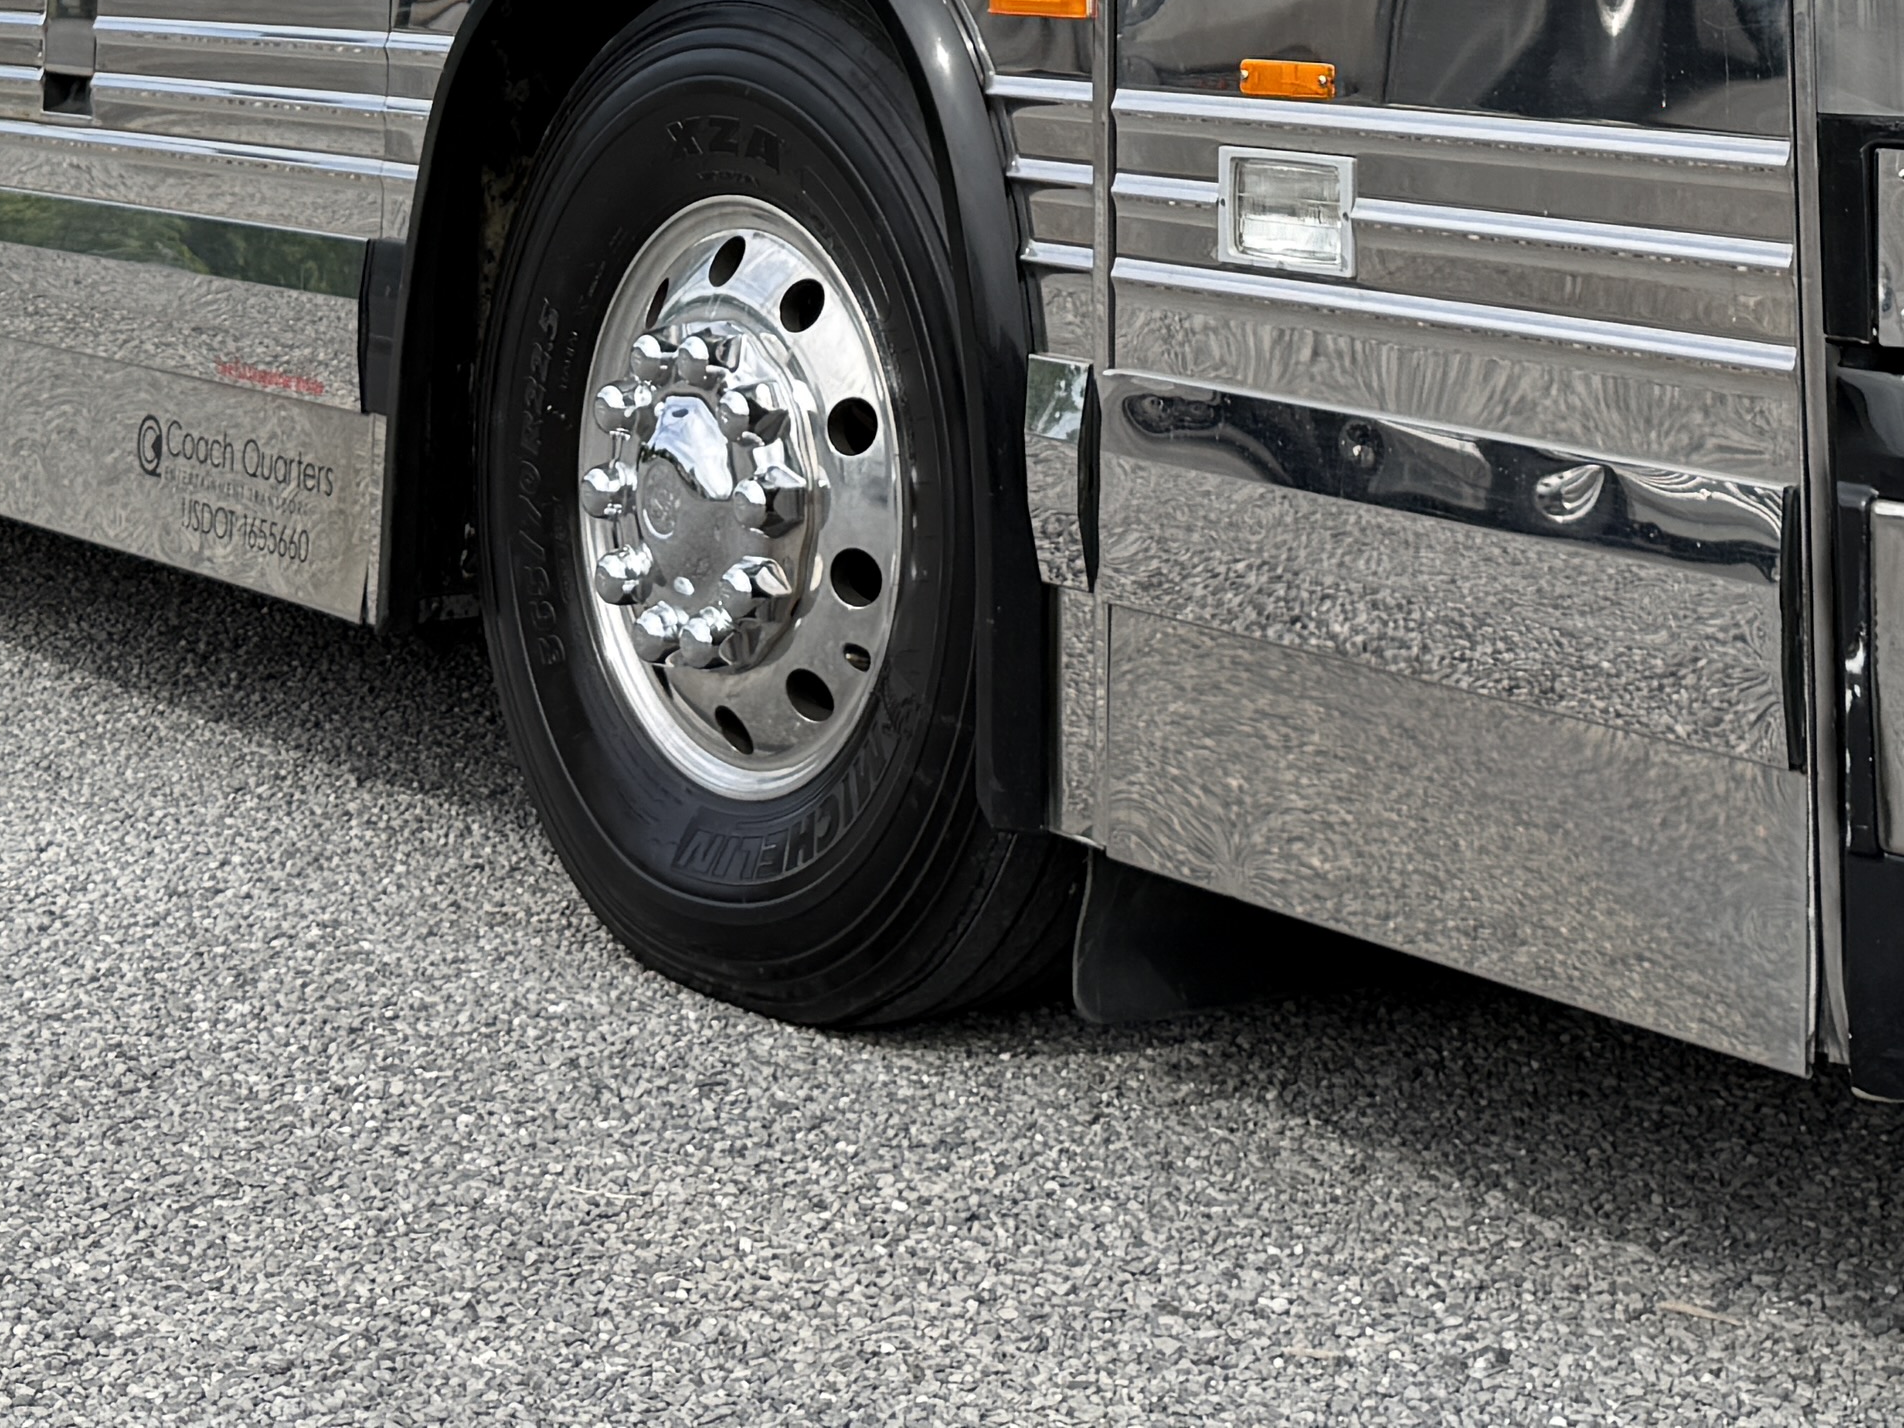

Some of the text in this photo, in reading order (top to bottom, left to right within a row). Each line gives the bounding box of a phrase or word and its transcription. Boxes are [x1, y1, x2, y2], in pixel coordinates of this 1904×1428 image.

[166, 419, 335, 498] Coach Quarters
[181, 496, 311, 564] USDOT 1655660
[673, 723, 890, 880] MICHELIN
